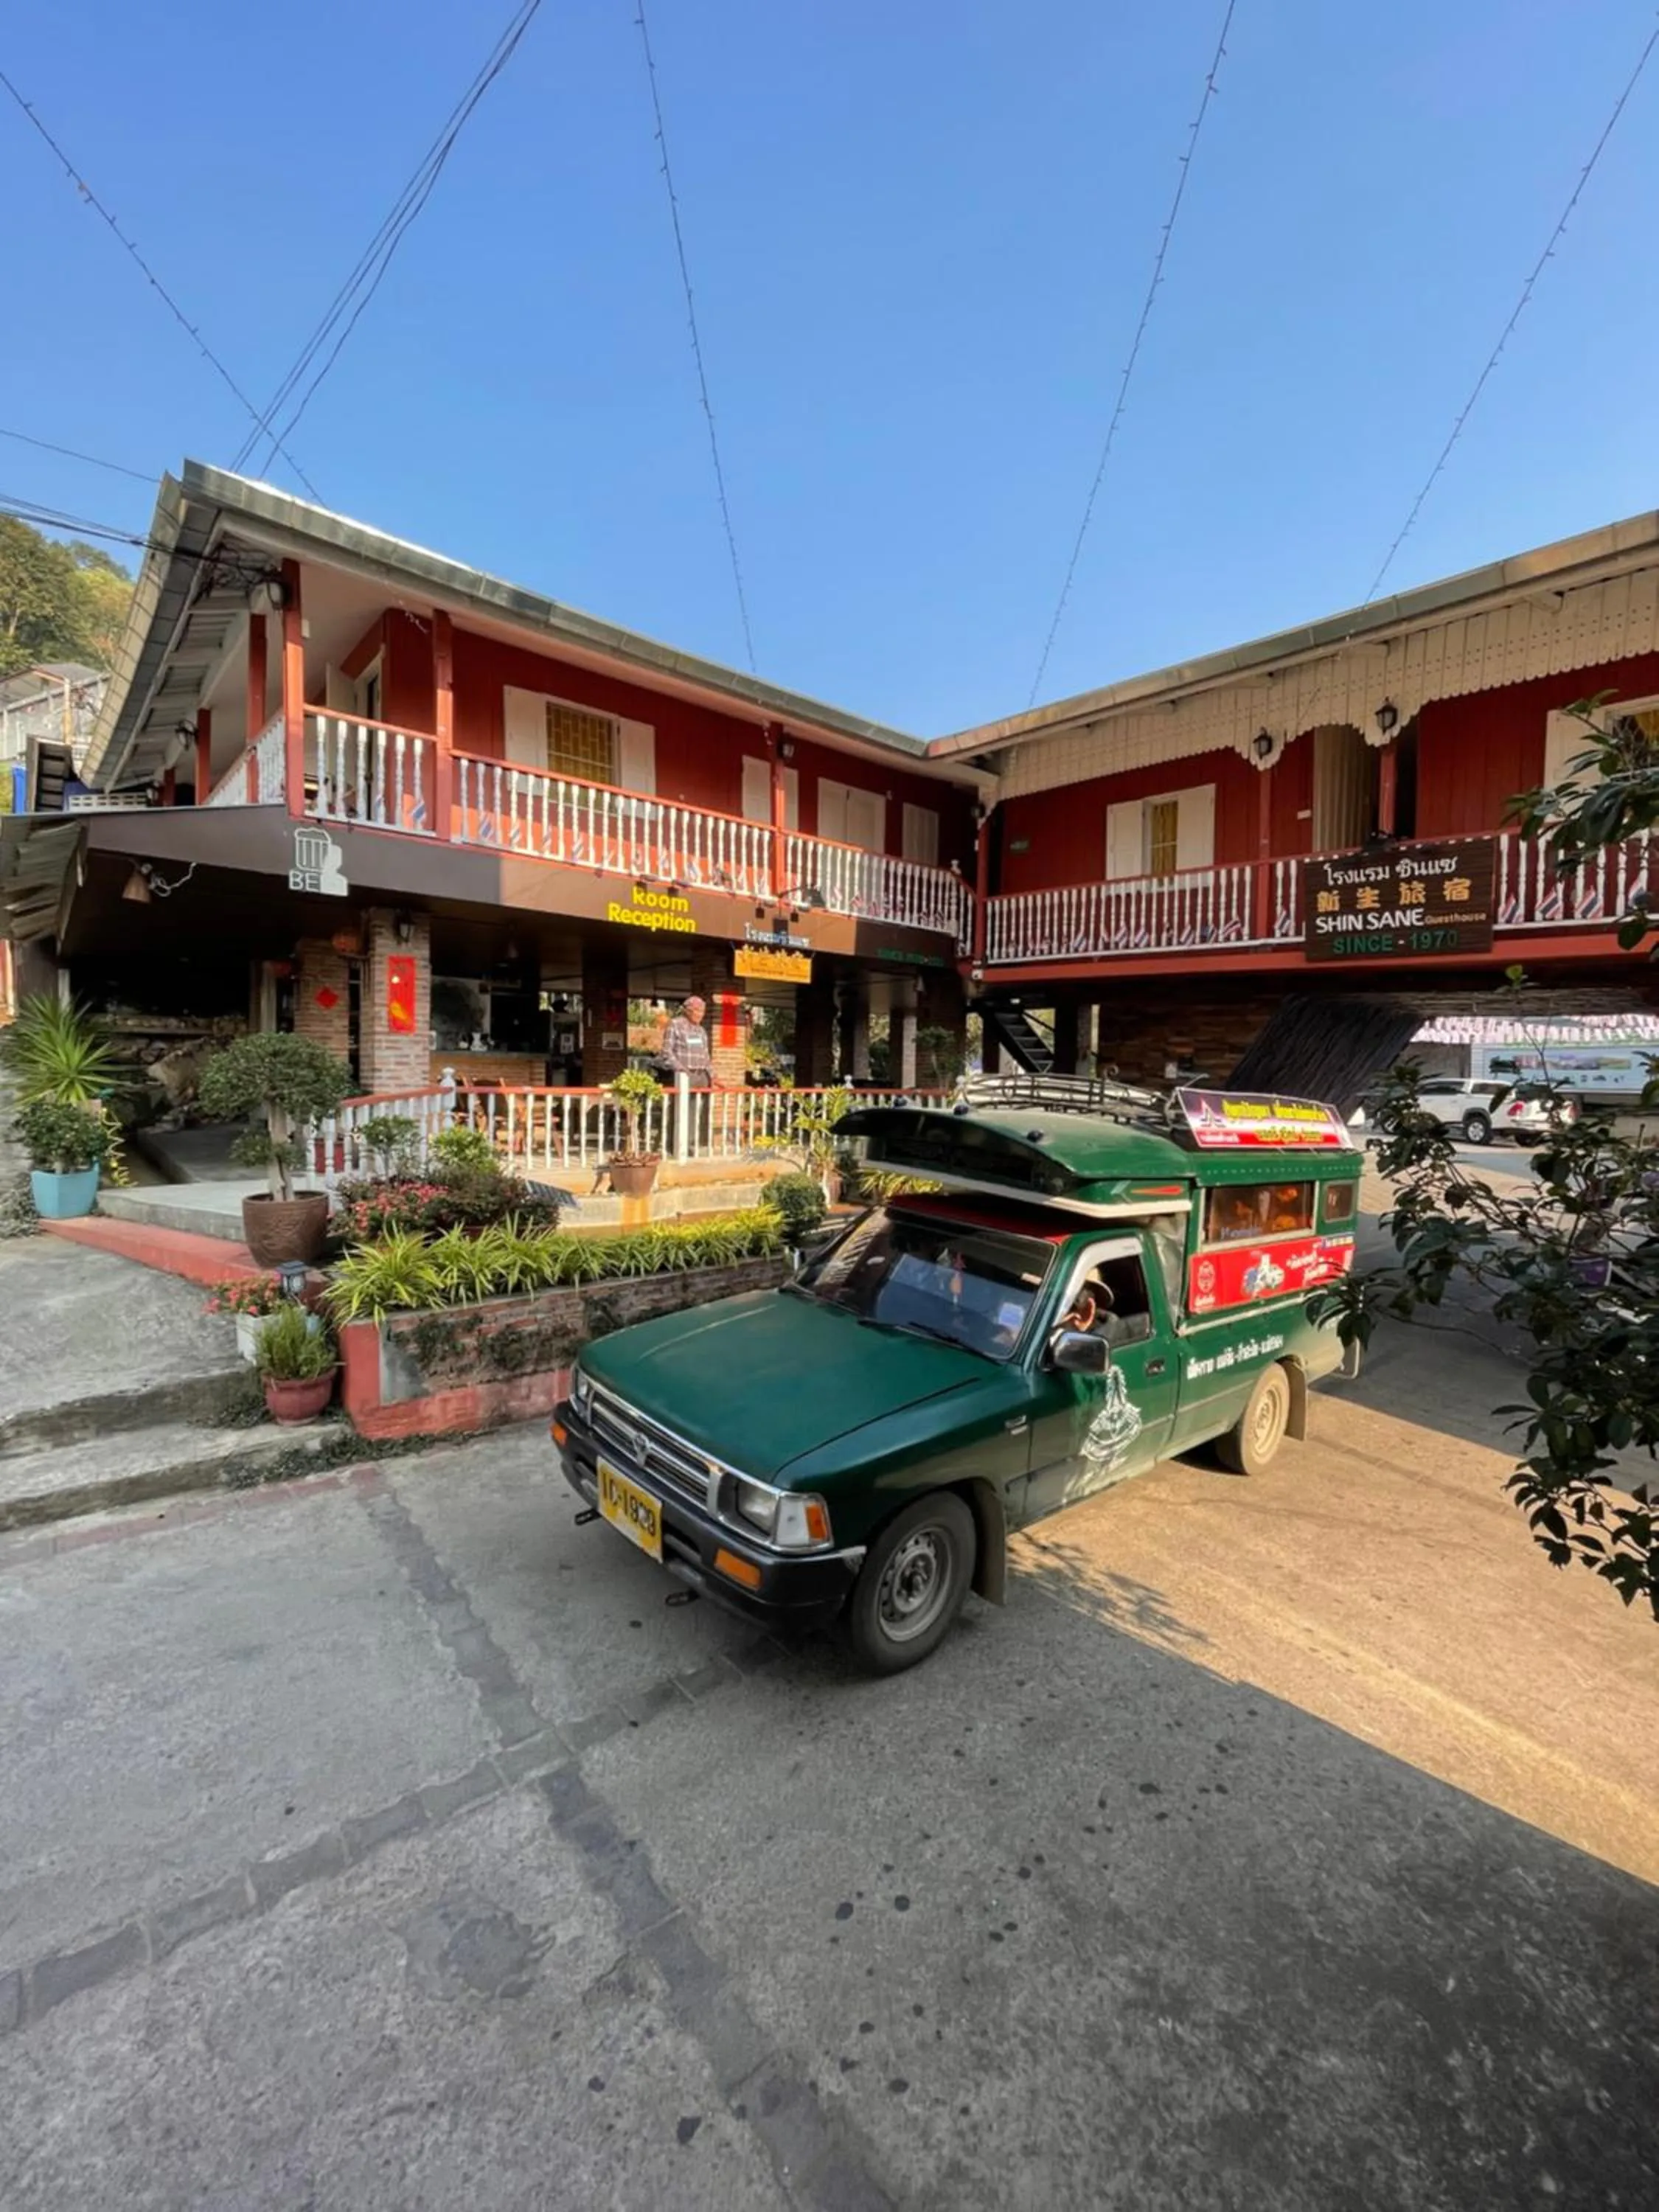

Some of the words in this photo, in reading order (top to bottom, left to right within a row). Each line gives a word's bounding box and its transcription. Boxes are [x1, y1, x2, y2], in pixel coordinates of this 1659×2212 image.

[1324, 863, 1390, 886] โรงแรม
[633, 885, 689, 913] Room
[608, 901, 697, 933] Reception
[1315, 914, 1364, 934] SHIN
[1366, 908, 1425, 931] SANE
[1333, 933, 1393, 954] SINCE
[1410, 929, 1458, 950] 1970
